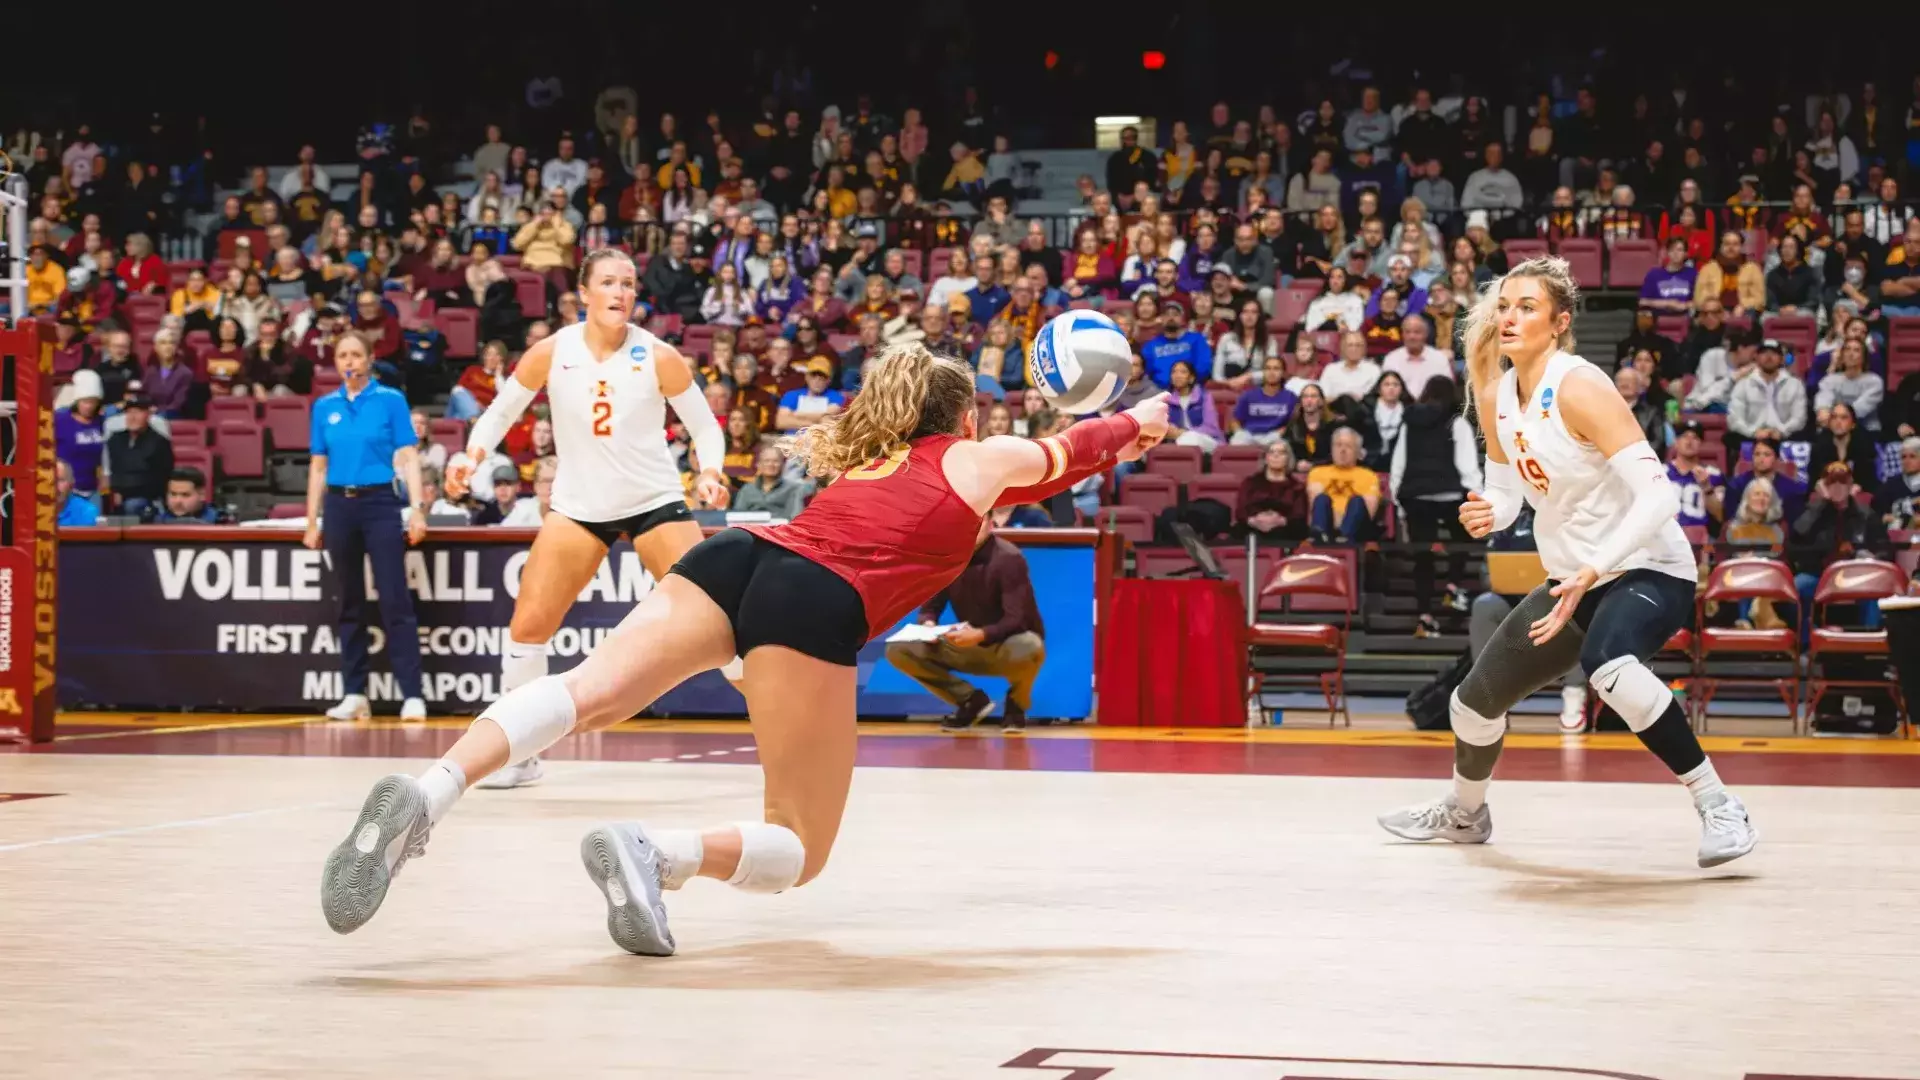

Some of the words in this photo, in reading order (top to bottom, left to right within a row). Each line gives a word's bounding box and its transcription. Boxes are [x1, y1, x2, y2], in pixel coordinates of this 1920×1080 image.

[593, 401, 613, 436] 2
[1516, 458, 1549, 495] 19
[34, 406, 56, 695] MINNESOTA
[153, 548, 494, 601] VOLLEALL
[217, 624, 308, 653] FIRST
